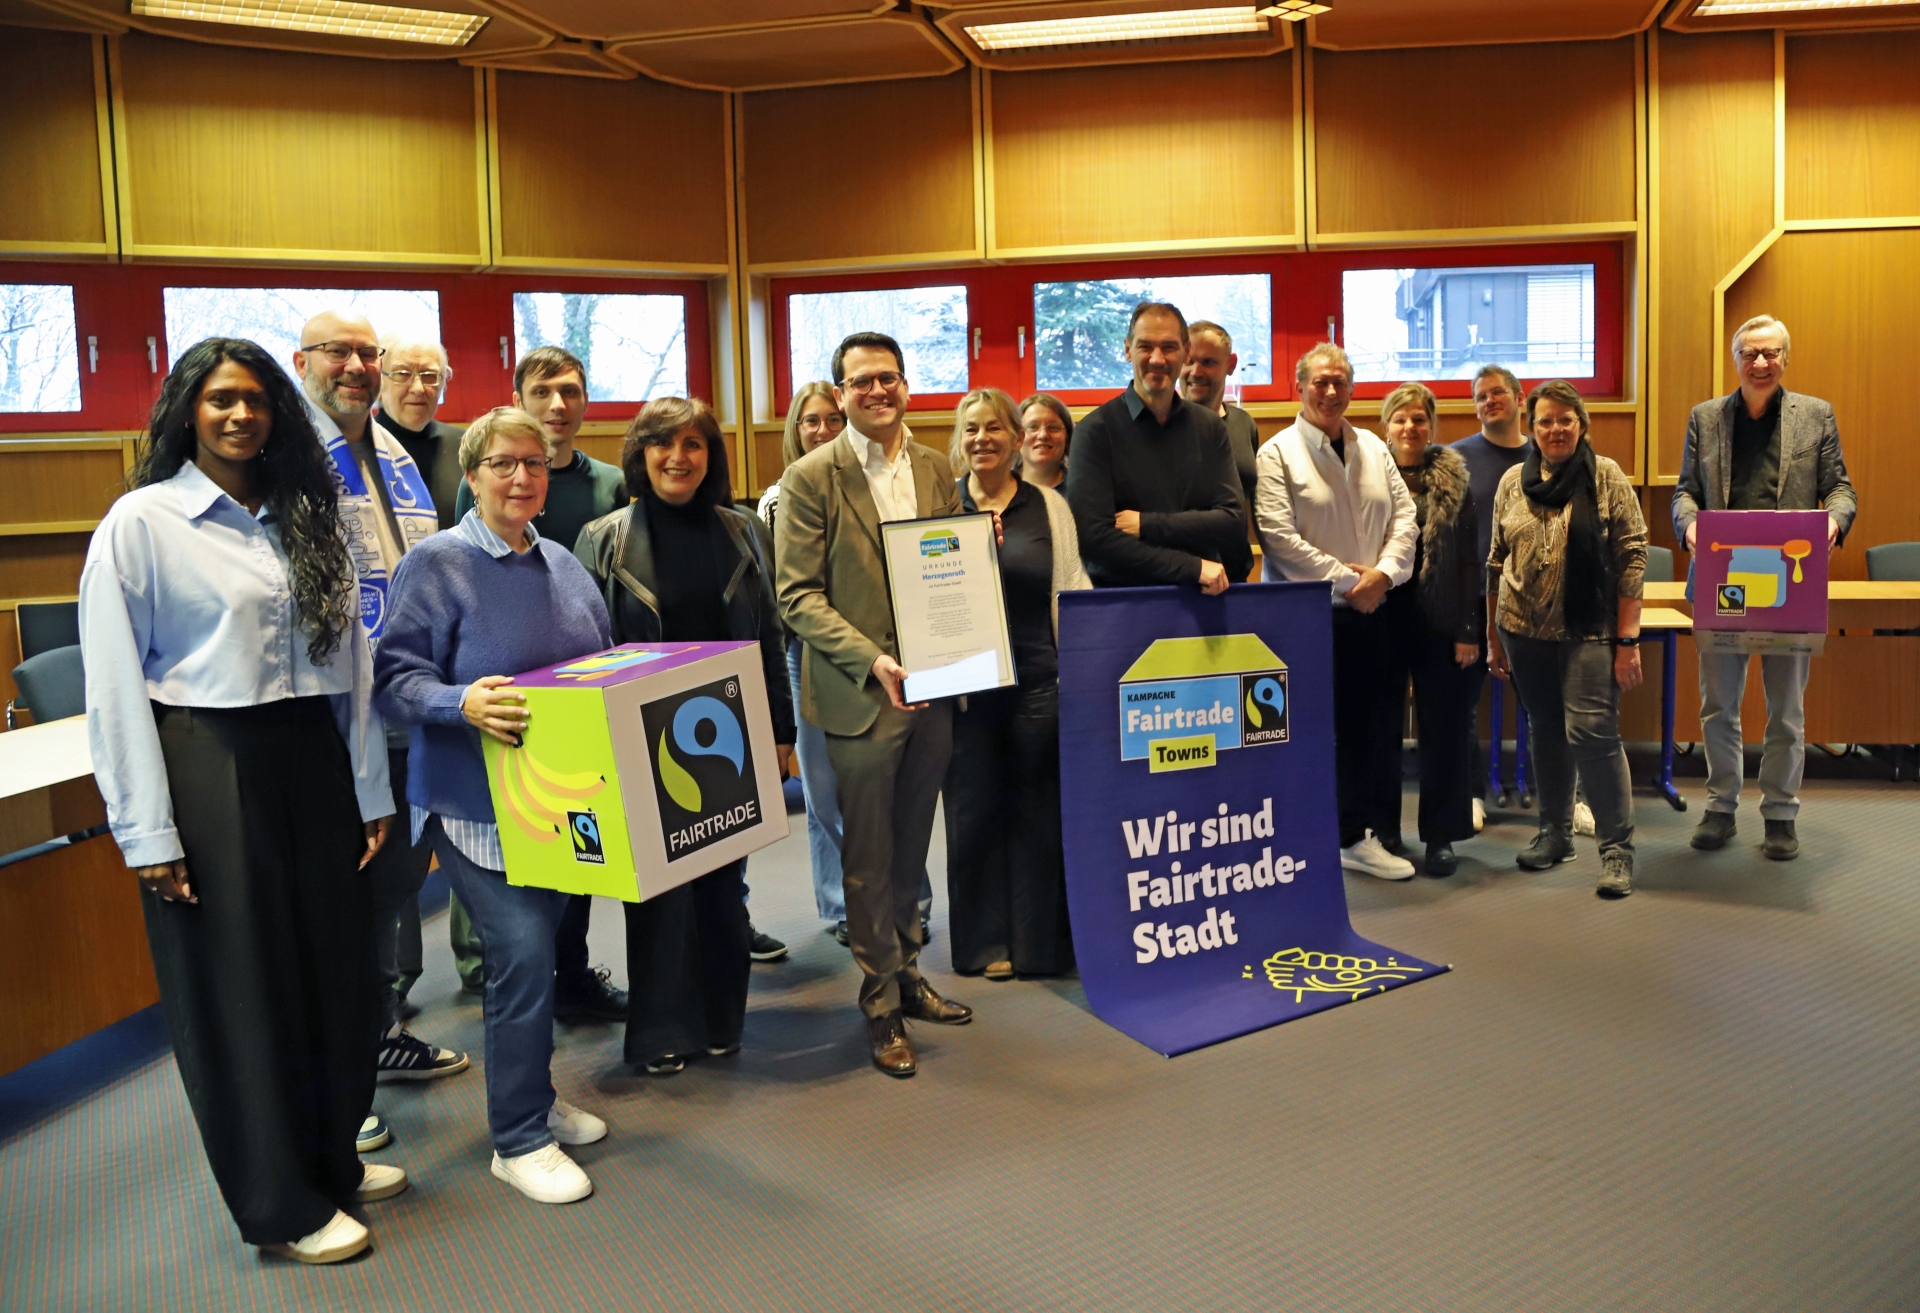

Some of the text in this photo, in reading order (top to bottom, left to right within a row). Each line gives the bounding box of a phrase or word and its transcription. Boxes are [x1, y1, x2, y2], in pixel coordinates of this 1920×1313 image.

[921, 543, 947, 551] Fairtrade
[922, 560, 962, 570] URKUNDE
[922, 570, 966, 580] Herzogenrath
[1127, 690, 1176, 702] KAMPAGNE
[1127, 700, 1235, 733] Fairtrade
[1246, 729, 1286, 742] FAIRTRADE
[1156, 745, 1209, 763] Towns
[669, 800, 757, 852] FAIRTRADE
[1122, 797, 1275, 859] Wir sind
[576, 852, 604, 862] FAIRTRADE
[1127, 846, 1306, 912] Fairtrade-
[1133, 907, 1238, 964] Stadt
